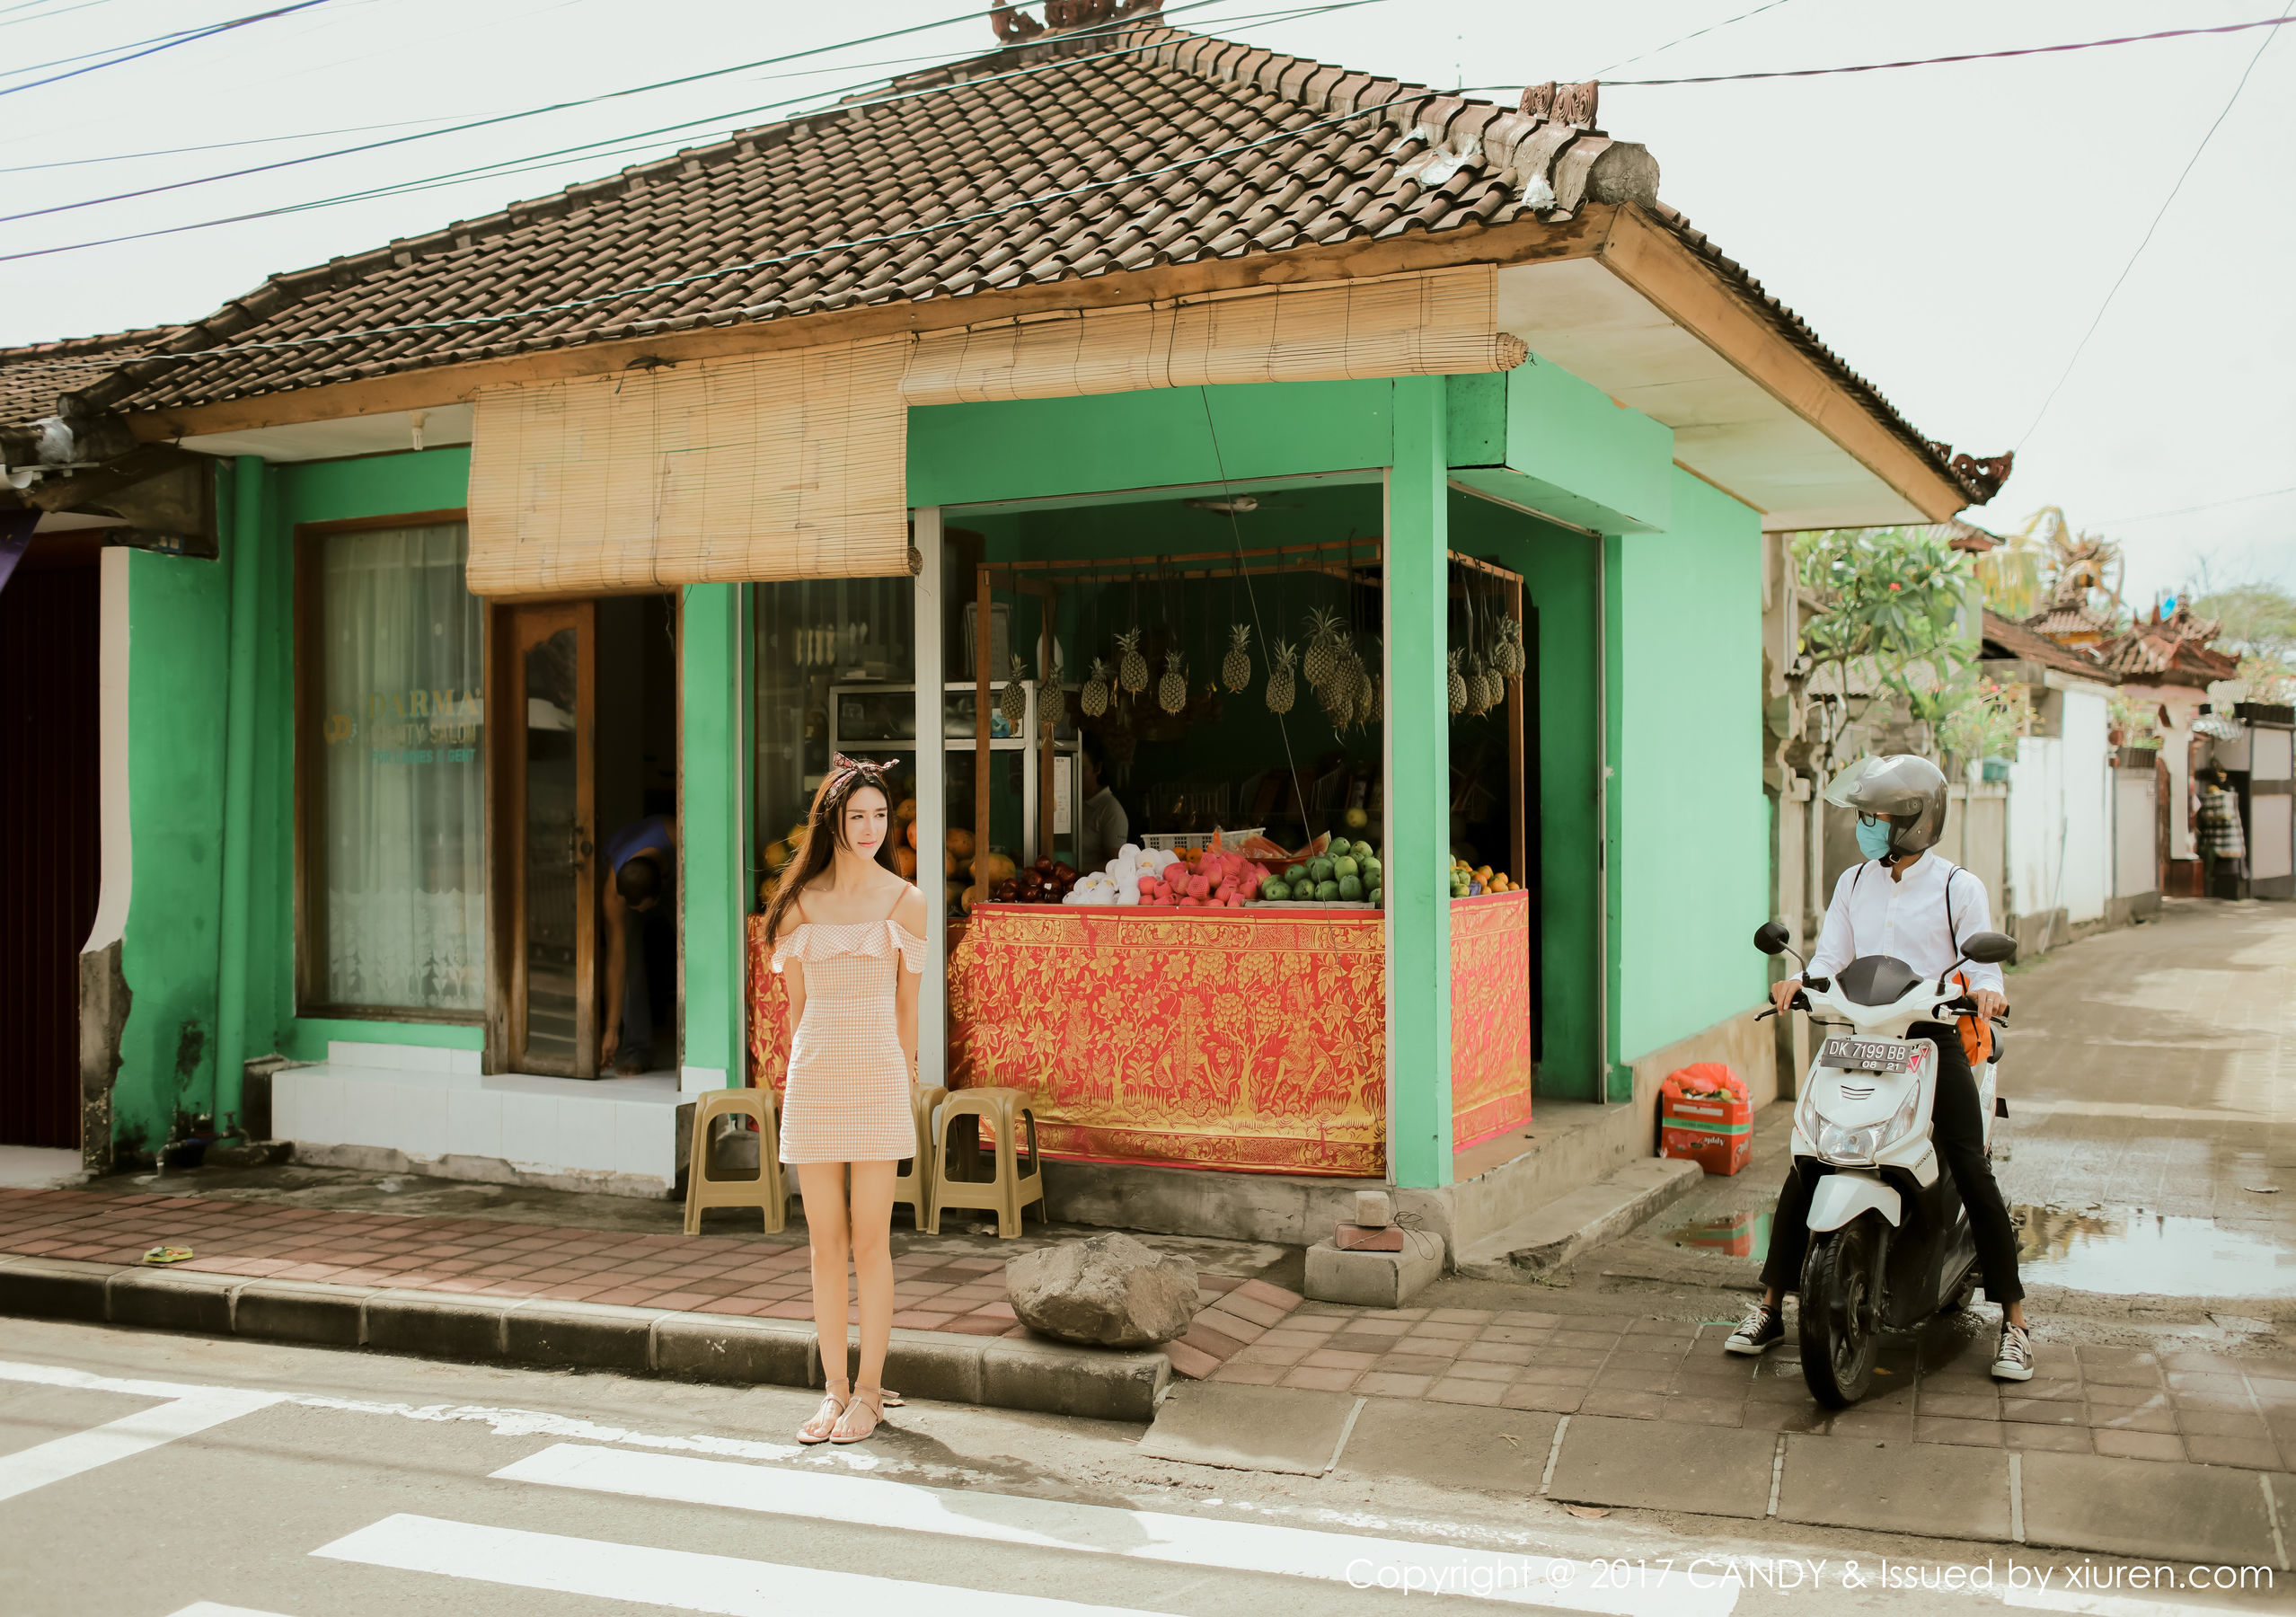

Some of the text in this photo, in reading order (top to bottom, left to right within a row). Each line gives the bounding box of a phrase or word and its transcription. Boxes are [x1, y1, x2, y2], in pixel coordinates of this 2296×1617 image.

[370, 724, 425, 745] UTY
[1829, 1041, 1850, 1056] DK
[1852, 1043, 1885, 1059] 7199
[1887, 1046, 1905, 1061] BB
[1861, 1061, 1900, 1071] 08 21
[1914, 1149, 1933, 1170] HONDA
